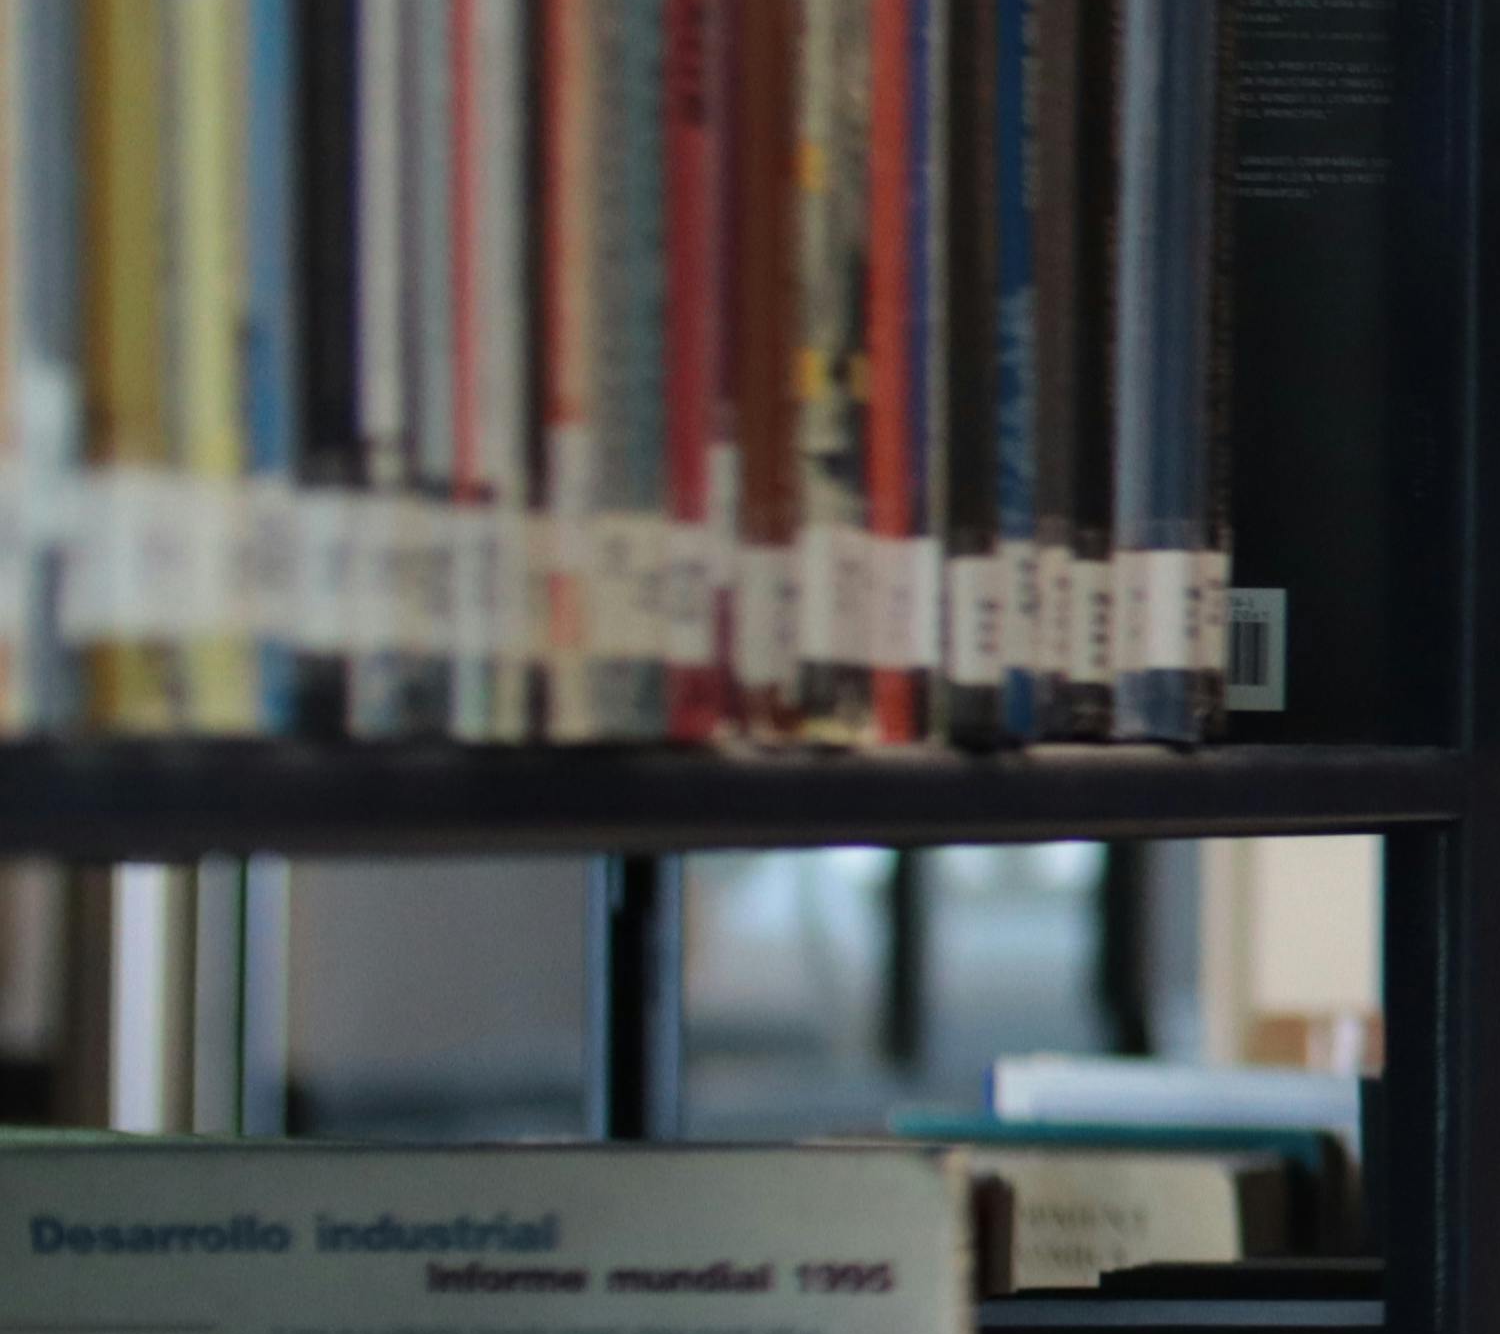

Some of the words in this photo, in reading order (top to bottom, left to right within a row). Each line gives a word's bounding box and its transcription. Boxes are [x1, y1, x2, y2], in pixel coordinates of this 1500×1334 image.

[28, 1213, 292, 1255] Desarrollo
[315, 1210, 561, 1255] industrial
[426, 1261, 587, 1296] Informe
[607, 1261, 774, 1296] mundial
[795, 1261, 895, 1296] 1995
